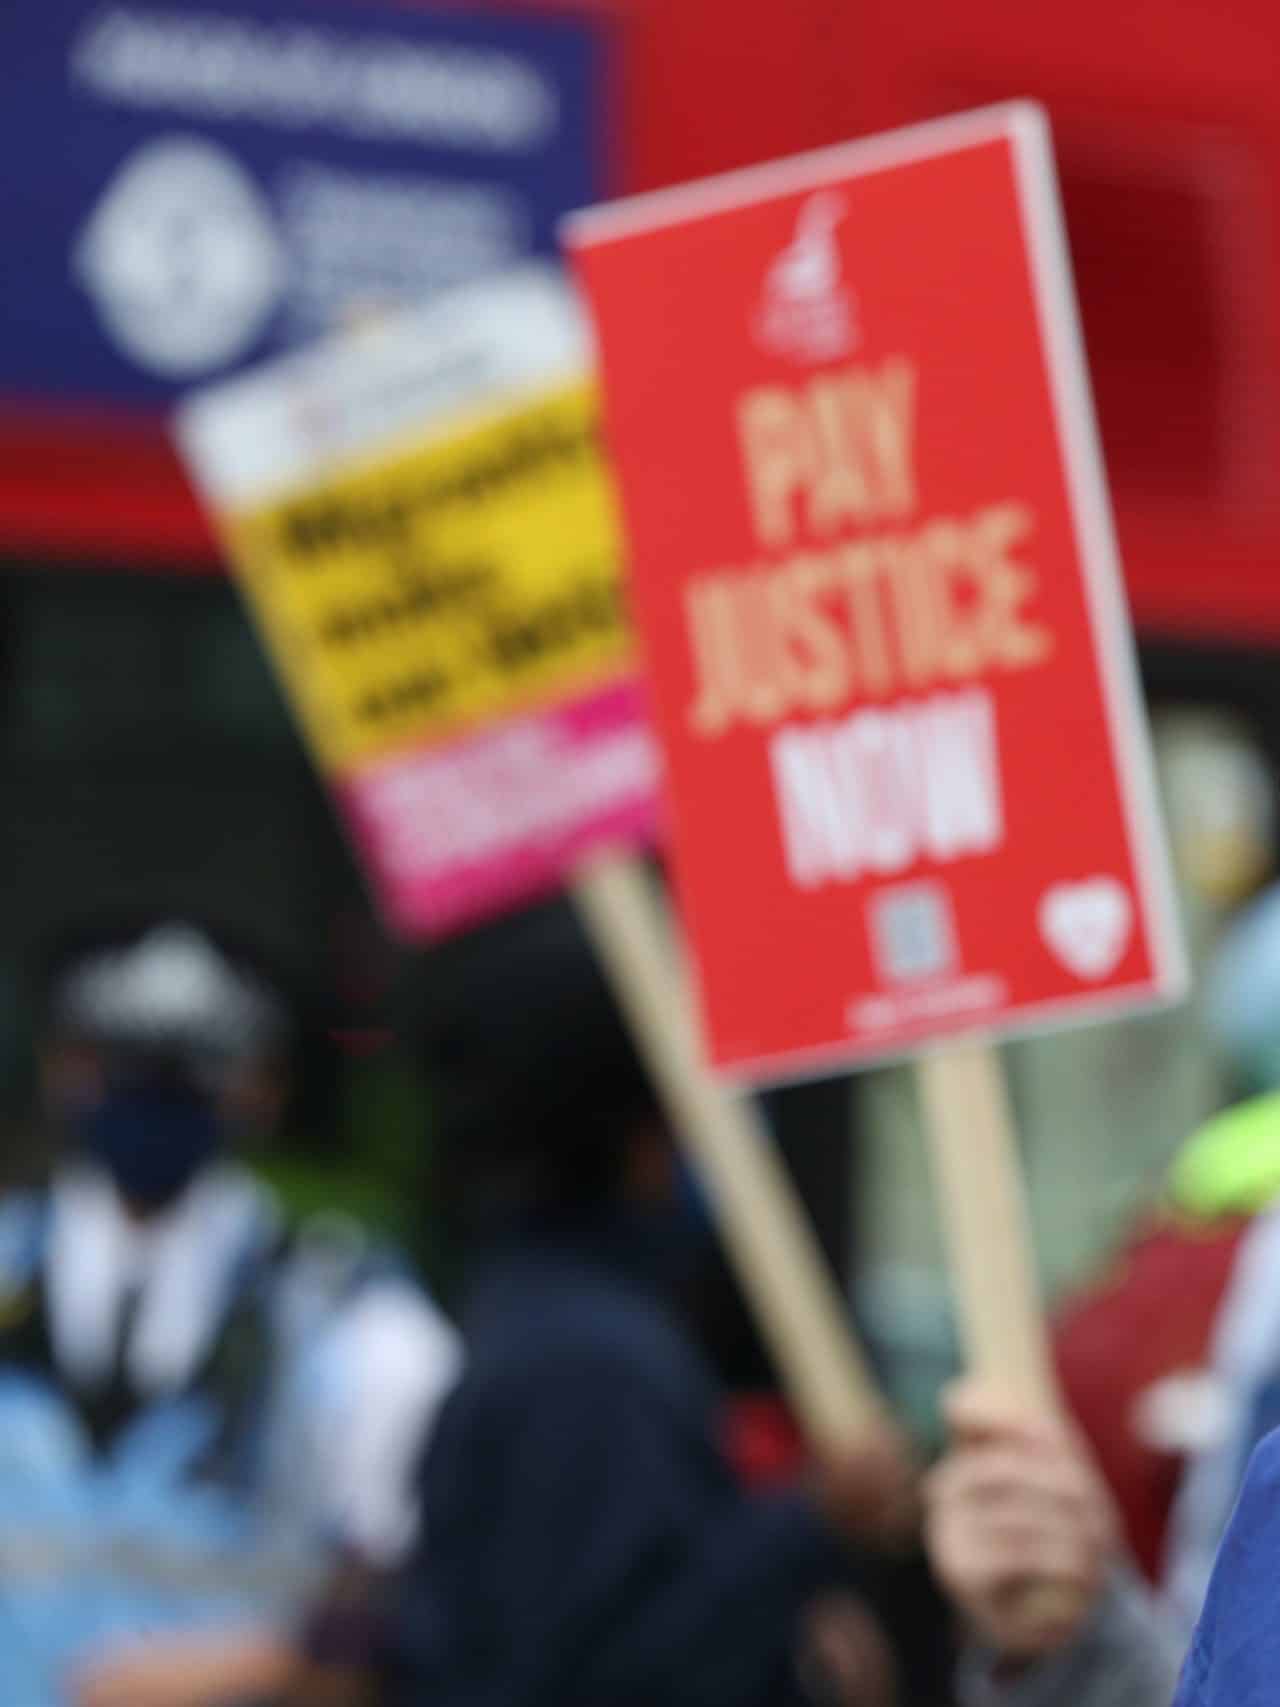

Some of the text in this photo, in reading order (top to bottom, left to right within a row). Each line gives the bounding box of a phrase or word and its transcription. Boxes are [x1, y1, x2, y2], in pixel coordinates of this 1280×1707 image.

[738, 361, 917, 546] PAY
[686, 506, 1050, 736] JUSTICE
[769, 690, 1002, 884] NOW
